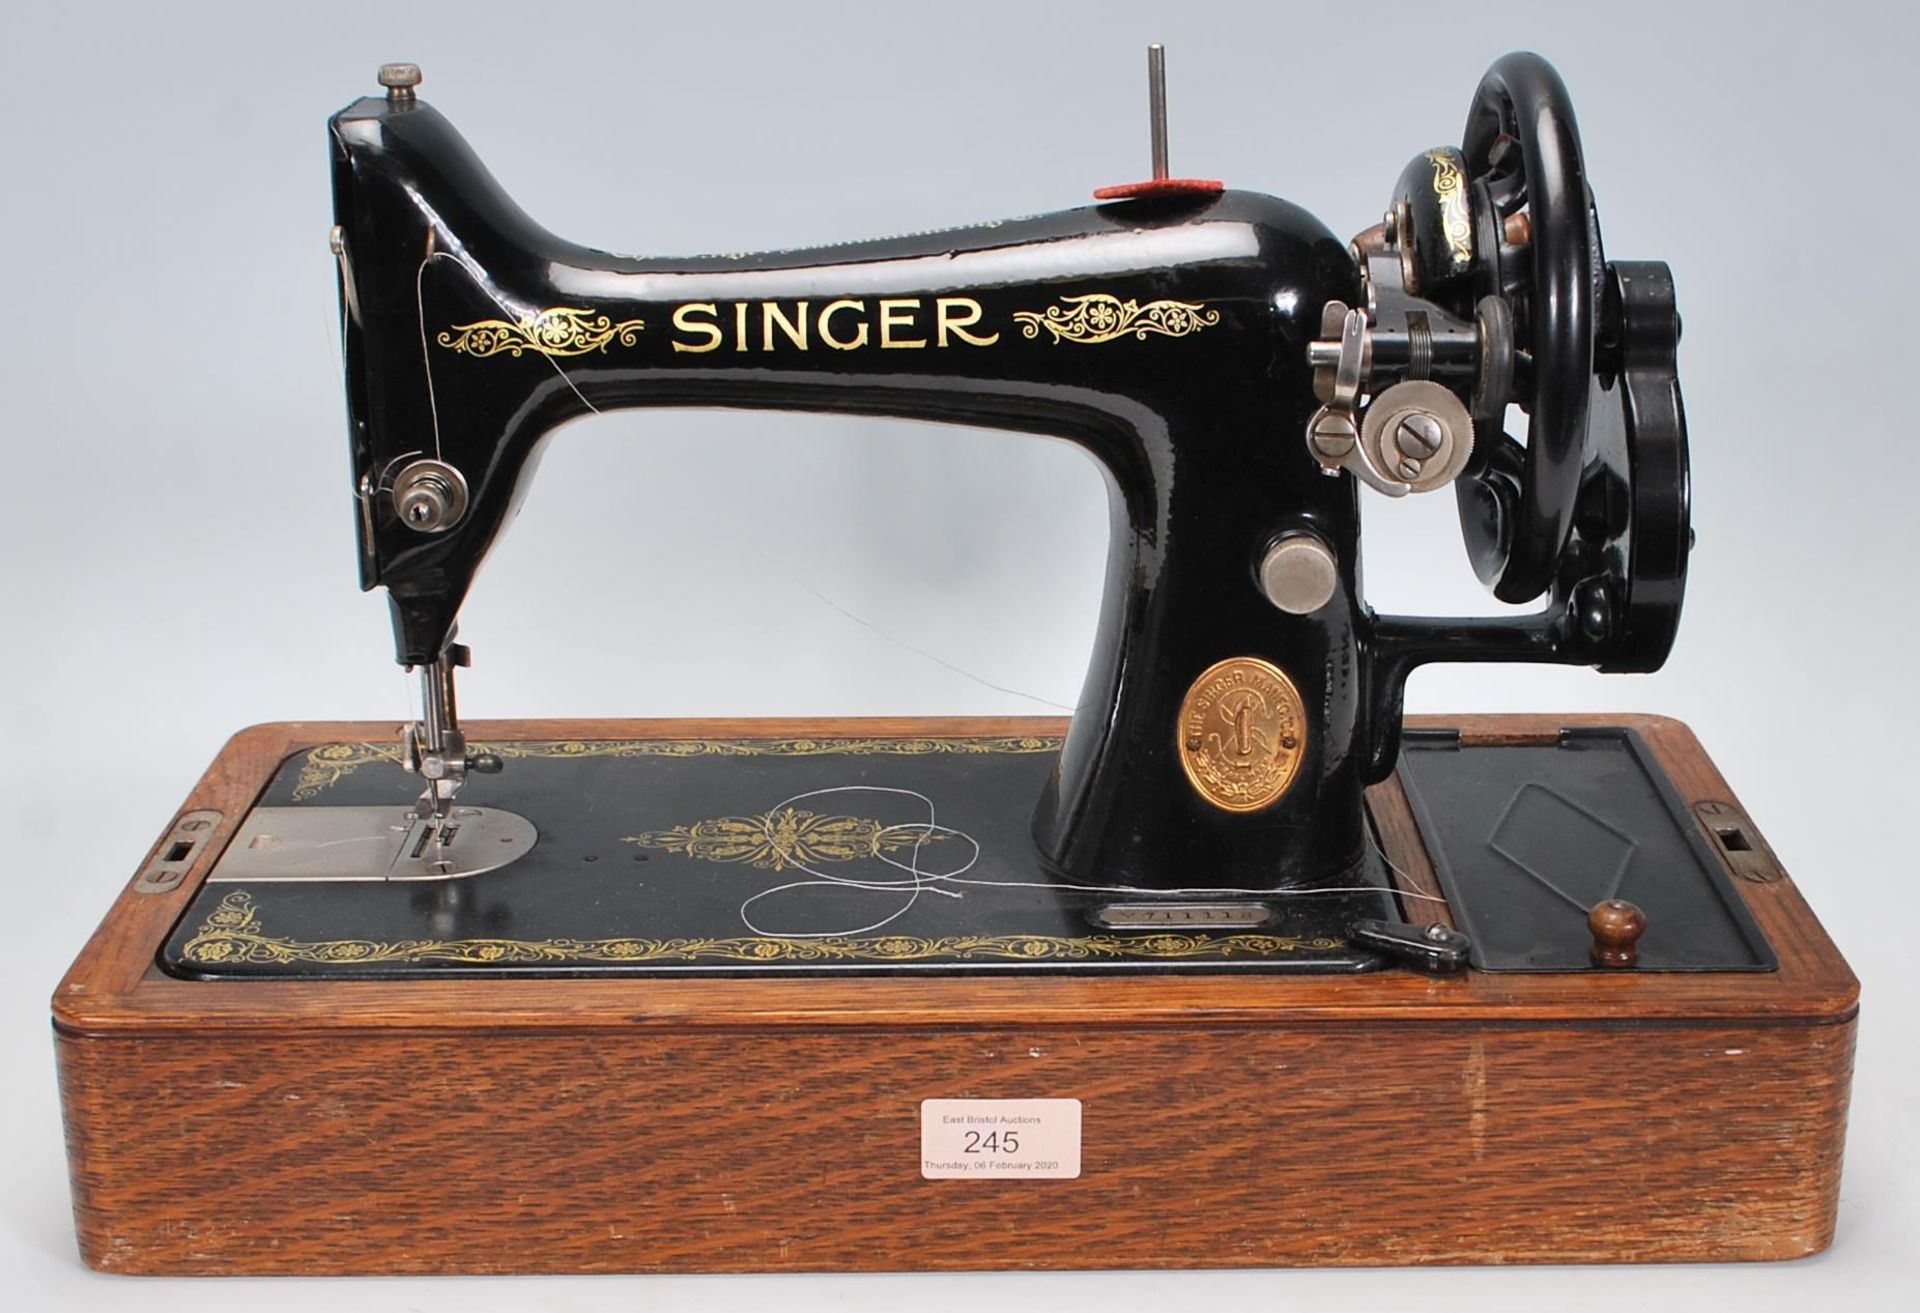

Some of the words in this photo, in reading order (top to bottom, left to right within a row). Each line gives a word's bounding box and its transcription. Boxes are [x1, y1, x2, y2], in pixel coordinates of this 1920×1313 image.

[671, 297, 1000, 353] SINGER
[1189, 710, 1205, 737] THE
[1197, 670, 1245, 708] SINGER
[943, 1115, 964, 1124] East
[967, 1115, 998, 1124] Bristol
[1000, 1115, 1041, 1124] Auctions
[964, 1130, 1019, 1154] 245
[924, 1161, 971, 1171] Thursday,
[974, 1161, 986, 1170] 06
[989, 1161, 1032, 1171] February
[1034, 1161, 1059, 1170] 2020
